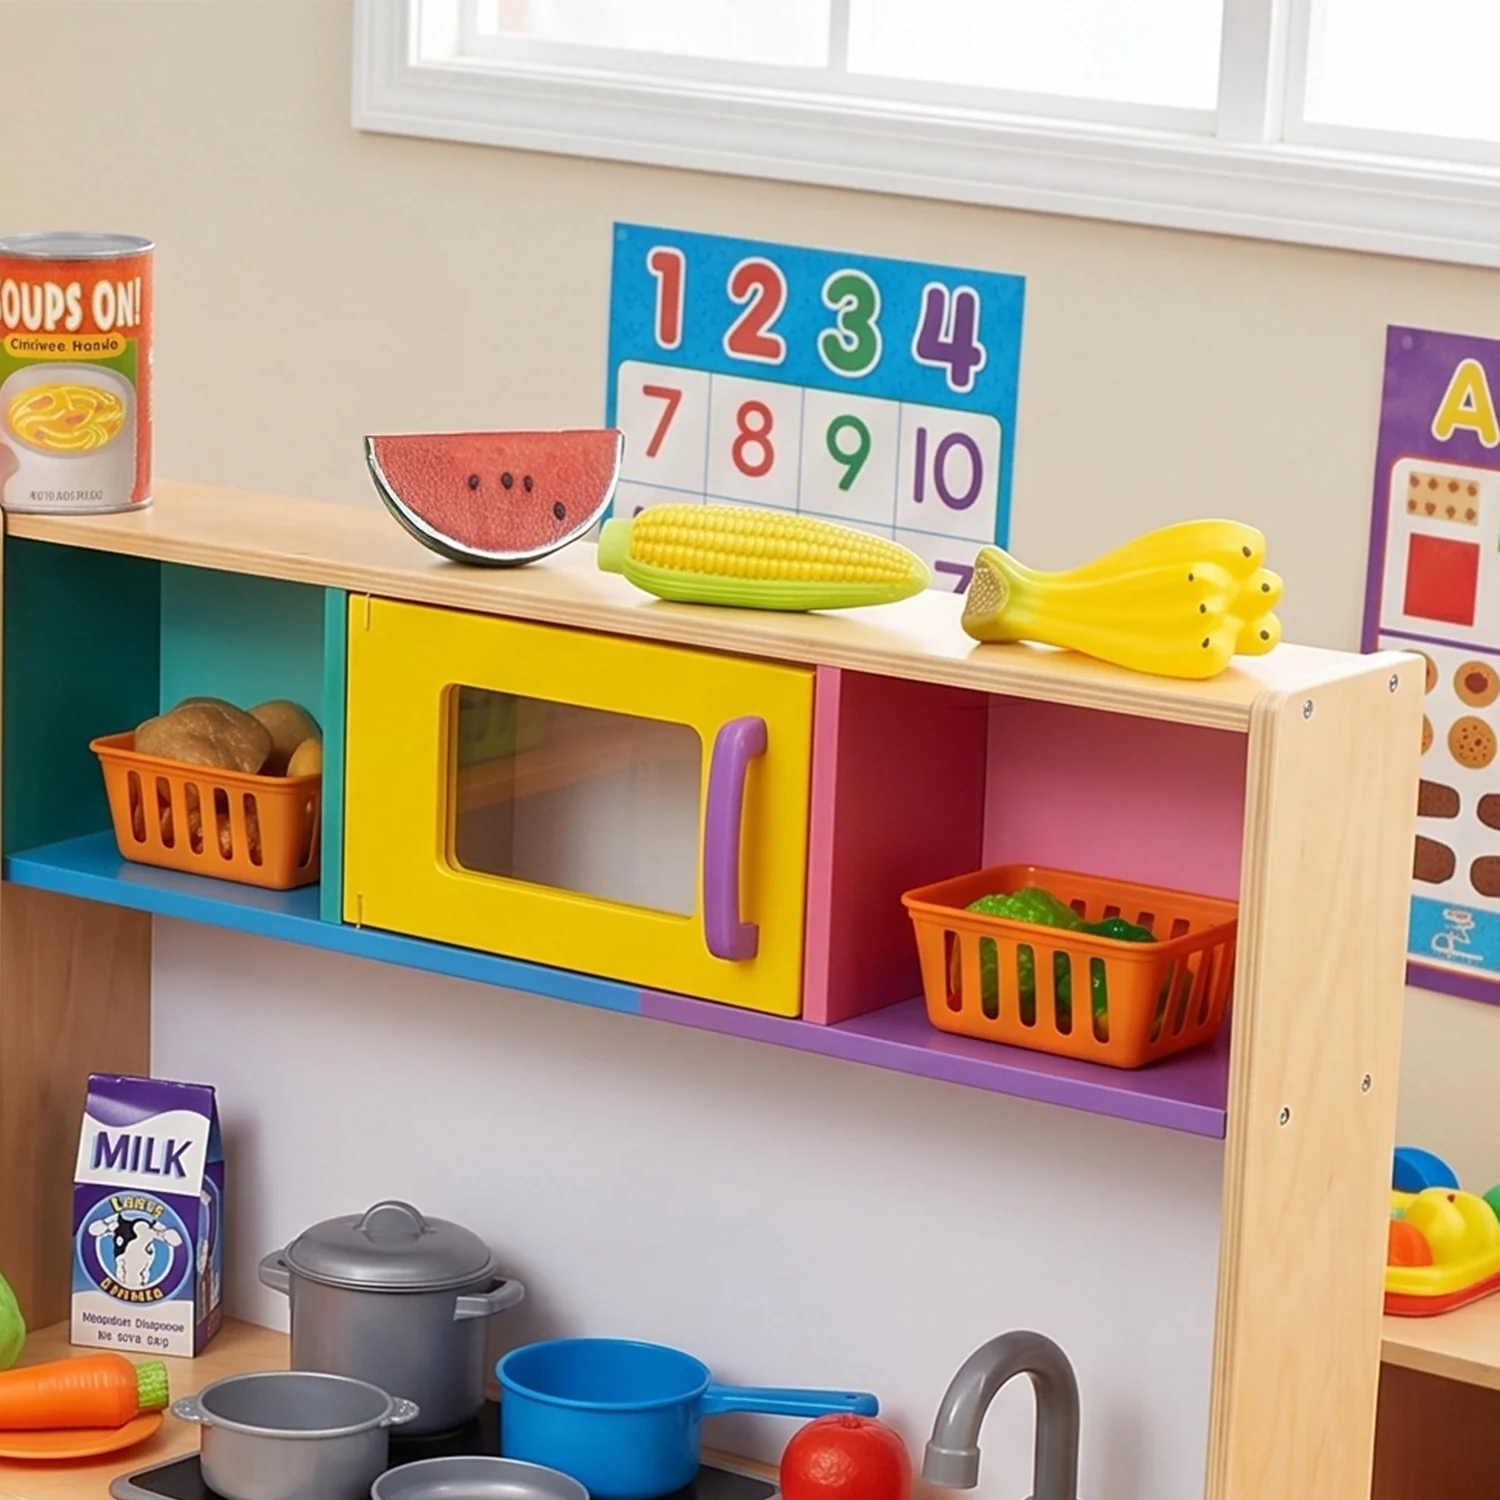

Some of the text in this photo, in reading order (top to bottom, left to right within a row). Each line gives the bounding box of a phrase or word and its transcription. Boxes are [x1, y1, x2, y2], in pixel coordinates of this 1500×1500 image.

[92, 276, 141, 331] ON!
[647, 247, 986, 393] 1 2 3 4
[642, 384, 983, 511] 7 8 9 10
[90, 1131, 193, 1178] MILK
